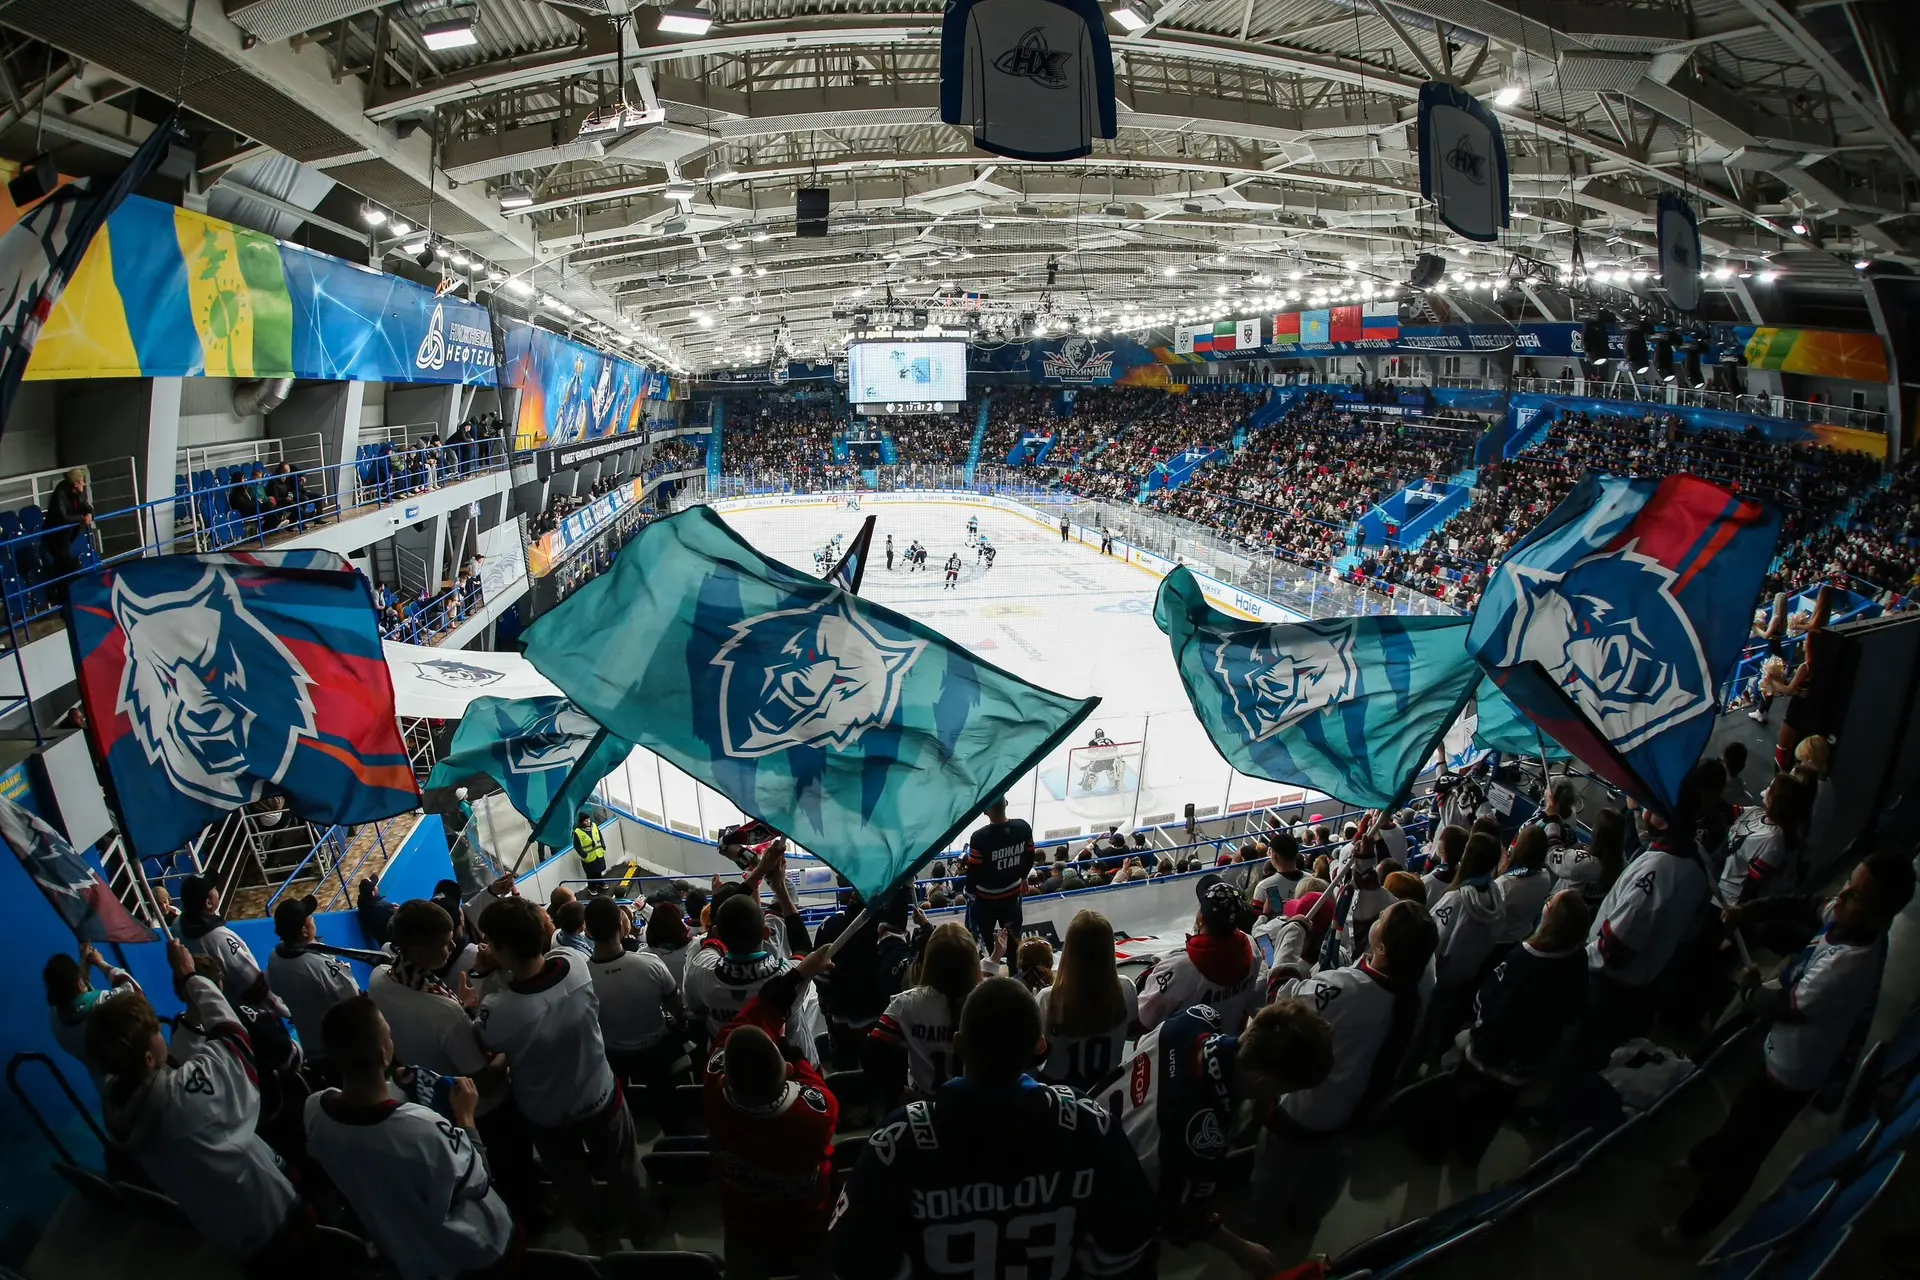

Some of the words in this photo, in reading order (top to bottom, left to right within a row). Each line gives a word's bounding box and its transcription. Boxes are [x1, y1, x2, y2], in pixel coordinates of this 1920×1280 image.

[1405, 335, 1462, 348] ТЕХНОЛОГИЯ
[446, 344, 502, 368] НЕФТЕХИ
[1235, 594, 1262, 617] Haier
[991, 840, 1026, 862] ВОЖАК
[1134, 1054, 1147, 1104] STOP
[911, 1171, 1061, 1220] SOKOLOV
[922, 1205, 1078, 1280] 93
